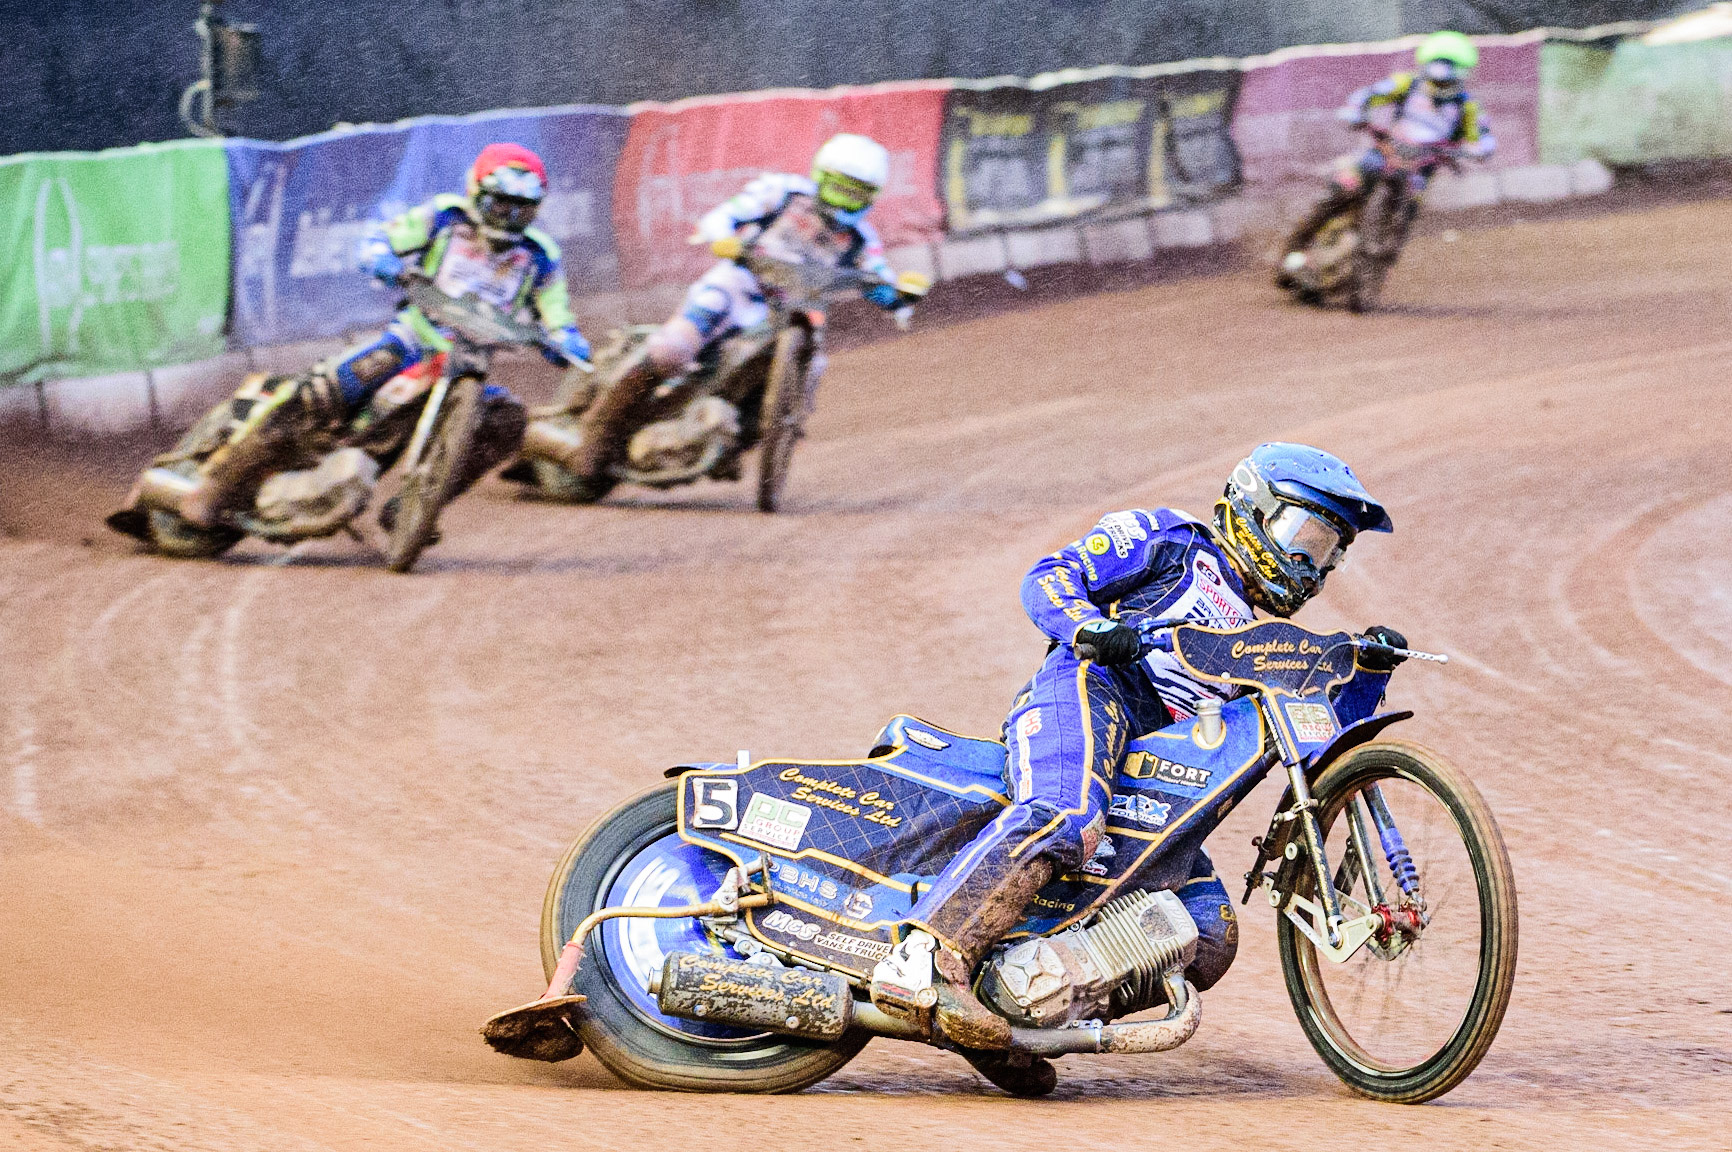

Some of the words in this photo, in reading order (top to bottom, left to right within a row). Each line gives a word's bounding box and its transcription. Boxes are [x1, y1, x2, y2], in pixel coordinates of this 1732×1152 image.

[1077, 545, 1099, 582] Racing
[1199, 578, 1239, 626] SPORTS
[1230, 640, 1296, 659] Complete
[1298, 639, 1323, 656] Car
[1252, 655, 1310, 672] Services
[1159, 759, 1212, 782] FORT
[699, 781, 732, 826] 5
[778, 767, 857, 799] Complete
[858, 791, 896, 812] Car
[790, 785, 861, 817] Services
[863, 808, 904, 828] Ltd
[754, 816, 802, 837] GROUP
[1031, 893, 1076, 913] Racing
[814, 936, 844, 951] VANS
[852, 945, 890, 963] TRUC
[826, 931, 857, 946] SELF
[858, 938, 891, 955] DRIVE
[678, 953, 774, 980] Complete
[780, 969, 824, 987] Car
[699, 972, 786, 1001] Services
[792, 986, 838, 1009] Ltd
